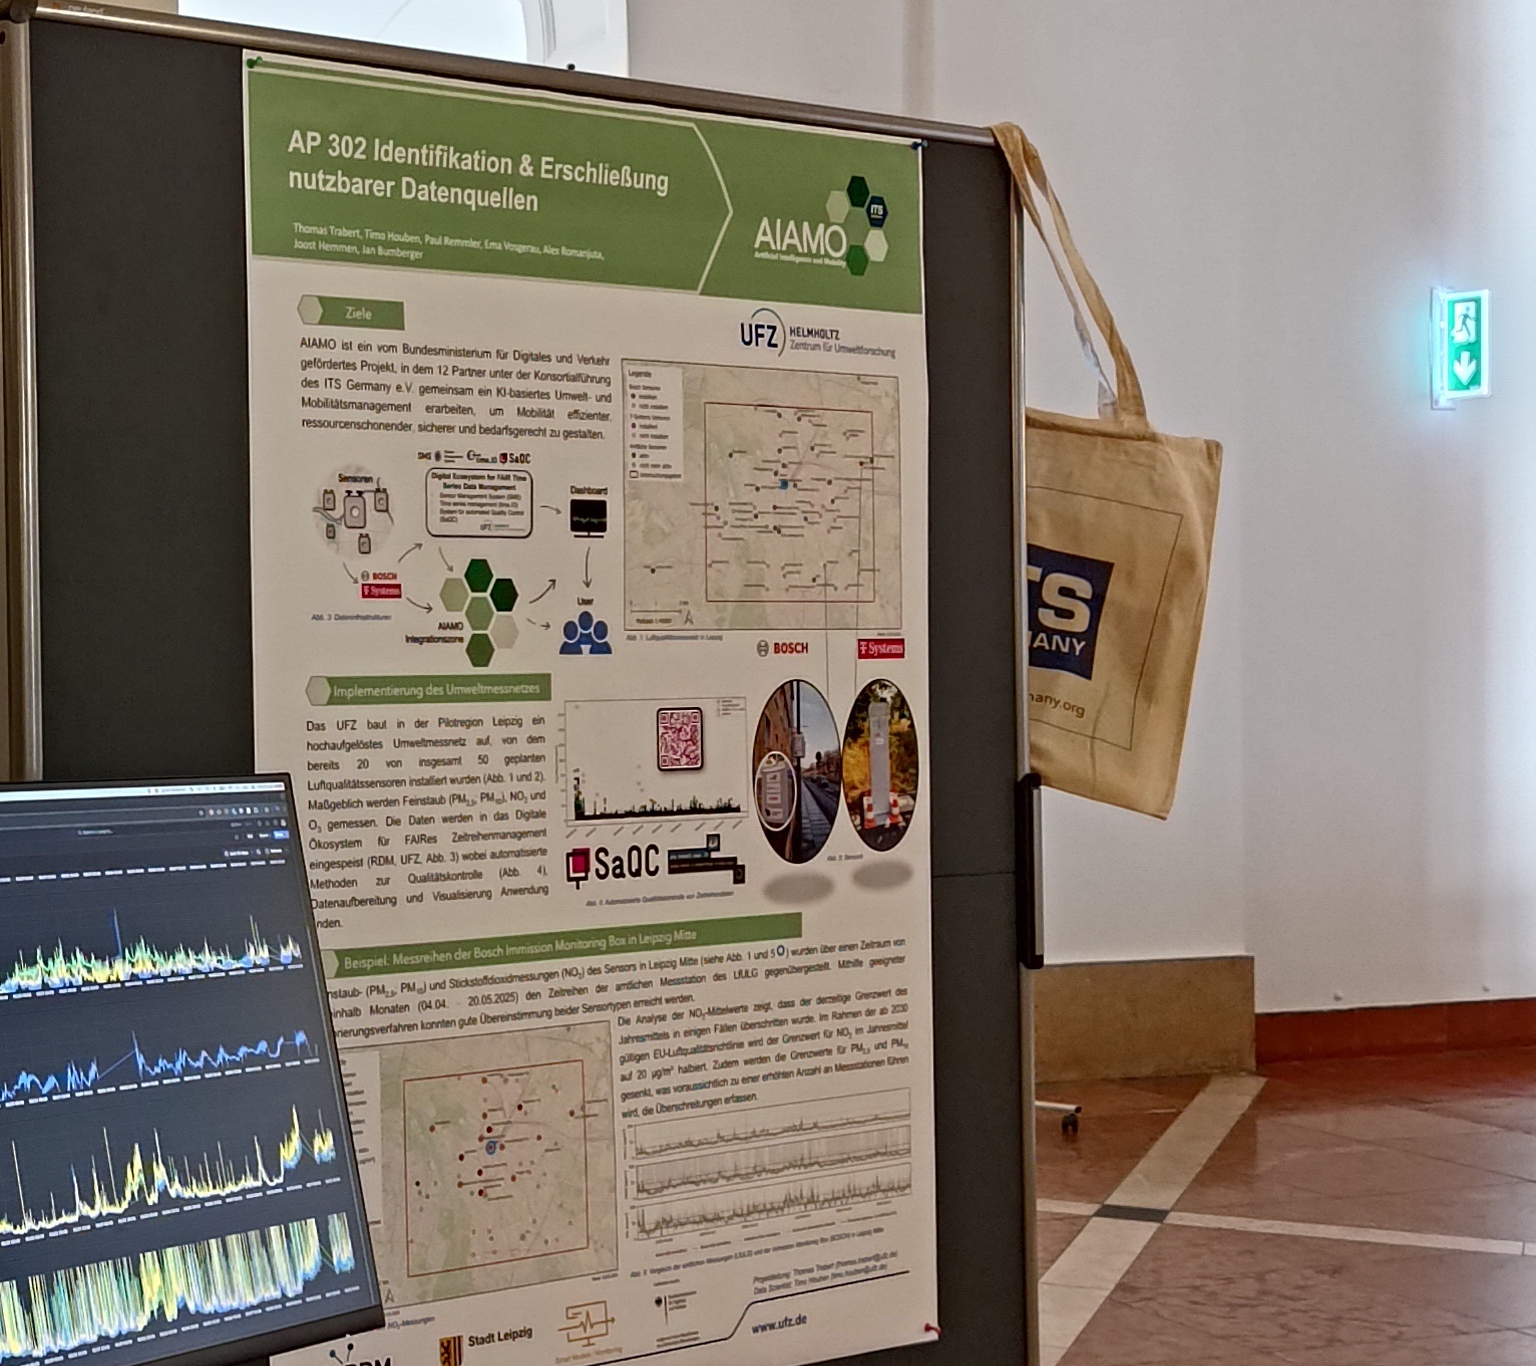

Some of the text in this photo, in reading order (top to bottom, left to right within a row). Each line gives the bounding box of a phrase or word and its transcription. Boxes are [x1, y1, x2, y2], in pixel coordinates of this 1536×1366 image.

[287, 129, 668, 196] AP 302 Identifikation & Erschließung
[289, 170, 538, 210] nutzbarer Datenquellen
[292, 222, 328, 235] Thomas
[387, 231, 422, 244] Houben,
[424, 234, 442, 245] Paul
[754, 217, 847, 258] AIAMO
[345, 306, 372, 320] Ziele
[740, 322, 778, 348] UFZ
[789, 326, 840, 340] HELMHOLTZ
[299, 337, 610, 365] AIAMO ist ein vom Bundesministerium für Digitales und Verkehr
[789, 339, 896, 359] Zentrum für Umweltforschung
[300, 357, 611, 387] gefördertes Projekt, in dem 12 Partner unter der Konsortialführung
[300, 376, 320, 388] des
[324, 377, 342, 389] ITS
[346, 378, 391, 394] Germany
[418, 384, 474, 396] gemeinsam
[477, 386, 492, 396] ein
[496, 386, 551, 399] KI-basiertes
[595, 393, 612, 403] und
[301, 396, 412, 413] Mobilitätsmanagement
[488, 407, 504, 416] um
[516, 406, 555, 418] Mobilität
[417, 421, 456, 433] sicherer
[458, 423, 476, 434] und
[478, 424, 547, 438] bedarfsgerecht
[548, 428, 560, 437] zu
[773, 641, 808, 654] BOSCH
[333, 683, 540, 699] Implementierung des Umweltmessnetzes
[306, 715, 545, 731] Das UFZ baut in der Pilotregion Leipzig ein
[306, 734, 546, 752] hochaufgelöstes Umweltmessnetz von dem
[306, 753, 546, 771] bereits 20 von insgesamt 50 geplanten
[307, 778, 406, 791] Luftqualitätssensoren
[408, 775, 447, 786] installiert
[448, 774, 481, 784] wurden
[509, 772, 514, 782] 1
[516, 771, 532, 782] und
[326, 809, 547, 832] gemessen. Daten Digitale
[308, 828, 547, 851] Ökosystem FAIRes Zeitreihenmanagement
[309, 850, 487, 871] eingespeist wobei
[596, 844, 659, 878] SaQC
[407, 869, 483, 883] Qualitätskontrolle
[392, 929, 697, 964] Messreihen der Bosch Immission Monitoring Box in Leipzig Mitte
[751, 1314, 807, 1333] www.ufz.de
[468, 1326, 533, 1346] Stadt Leipzig
